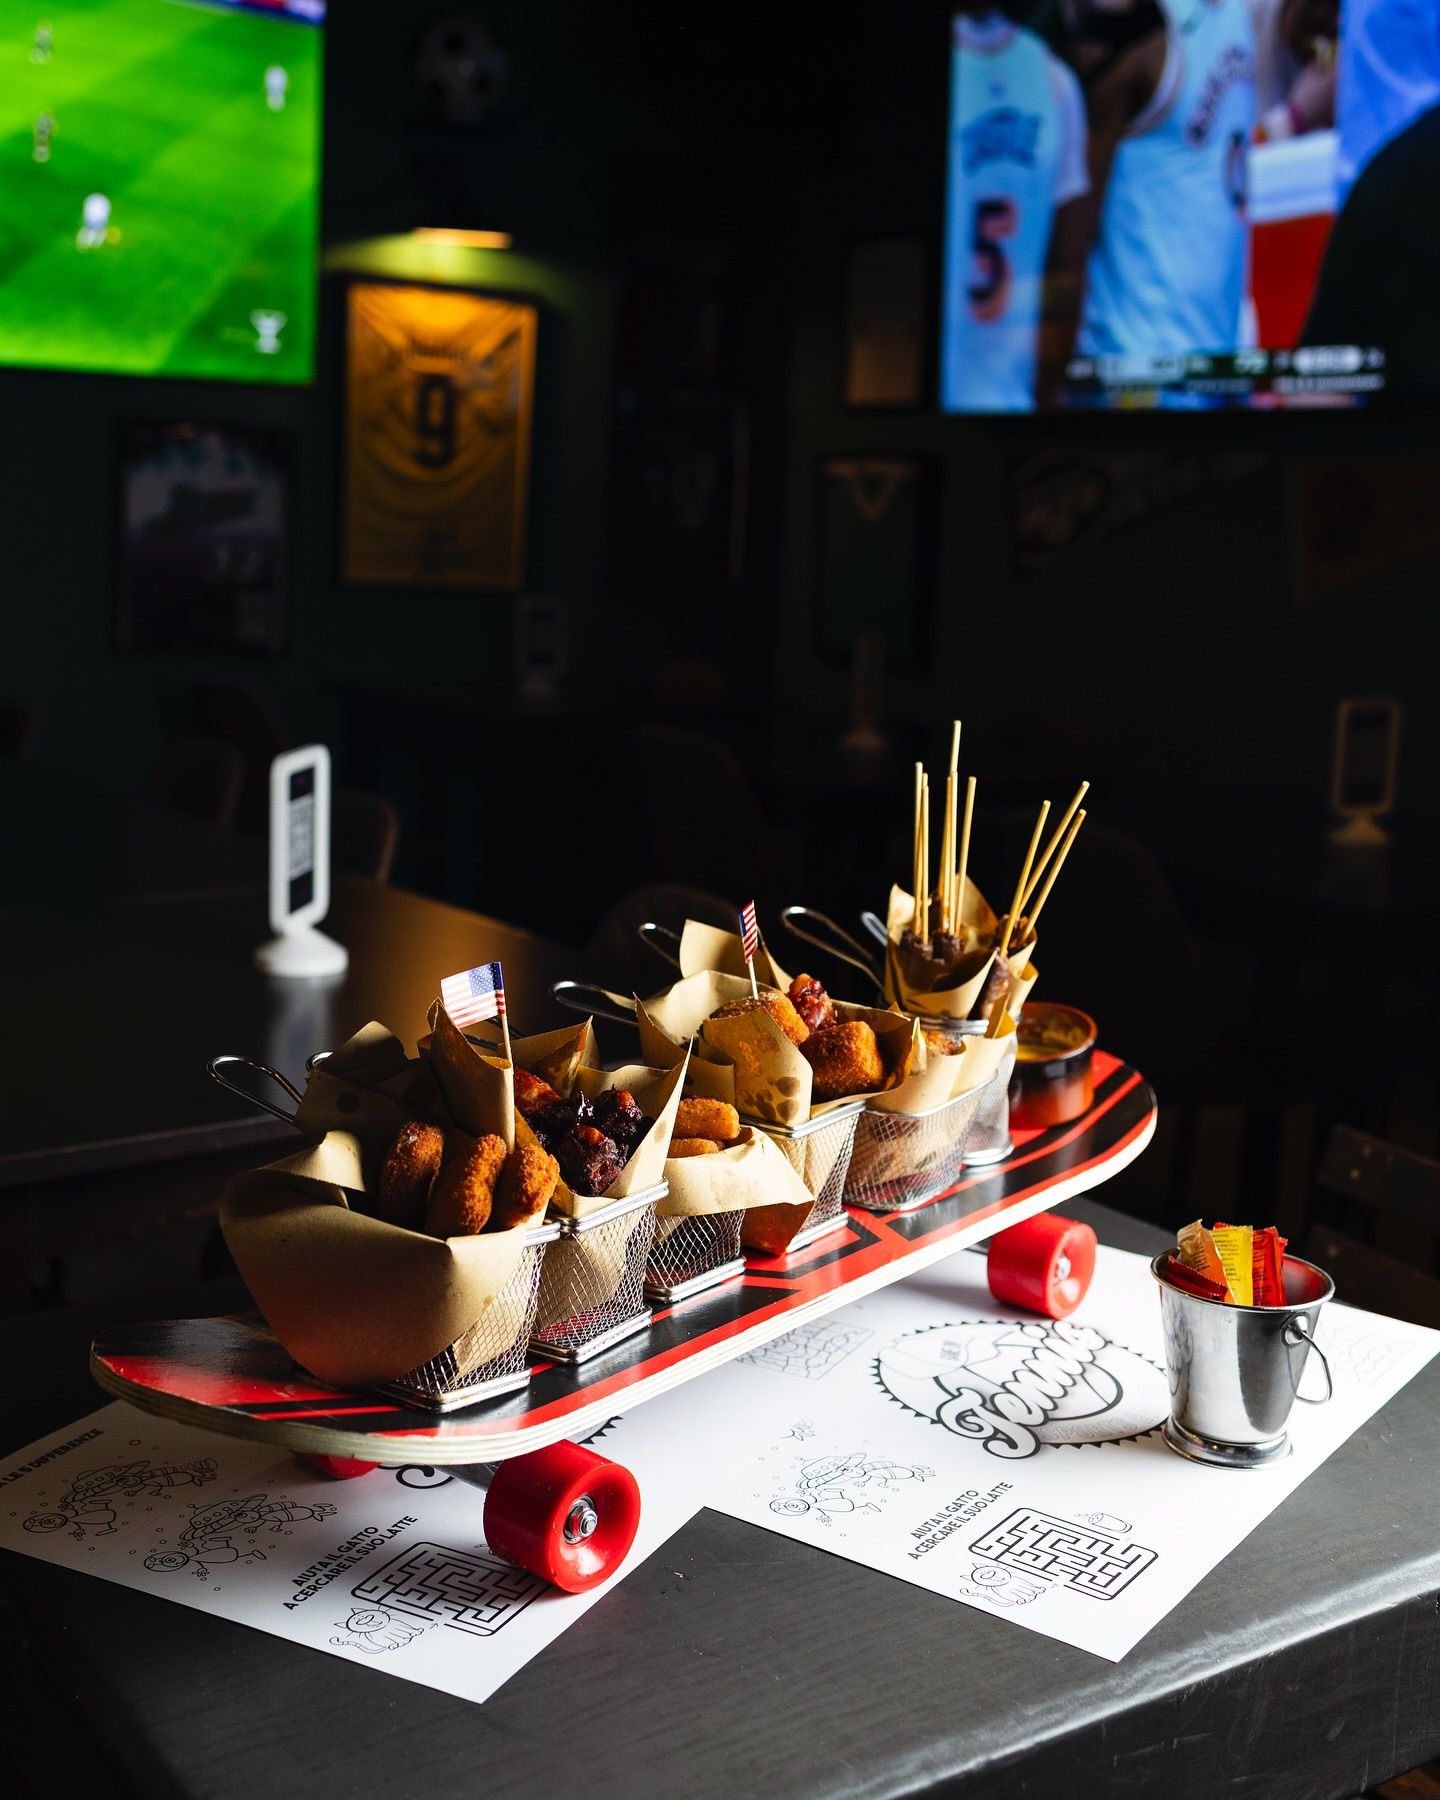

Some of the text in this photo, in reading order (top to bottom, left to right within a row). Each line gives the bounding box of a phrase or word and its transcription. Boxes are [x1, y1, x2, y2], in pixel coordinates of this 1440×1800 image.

[966, 198, 1021, 321] 5
[413, 375, 457, 467] 9
[2, 1471, 24, 1482] LE
[28, 1428, 105, 1468] DIFFERENZE
[907, 1482, 1013, 1560] A CERCARE IL SUO LATTE
[910, 1490, 979, 1540] AIUTA IL GATTO
[283, 1515, 419, 1611] A CERCARE IL SUO LATTE
[292, 1526, 379, 1587] AIUTA IL GATTO
